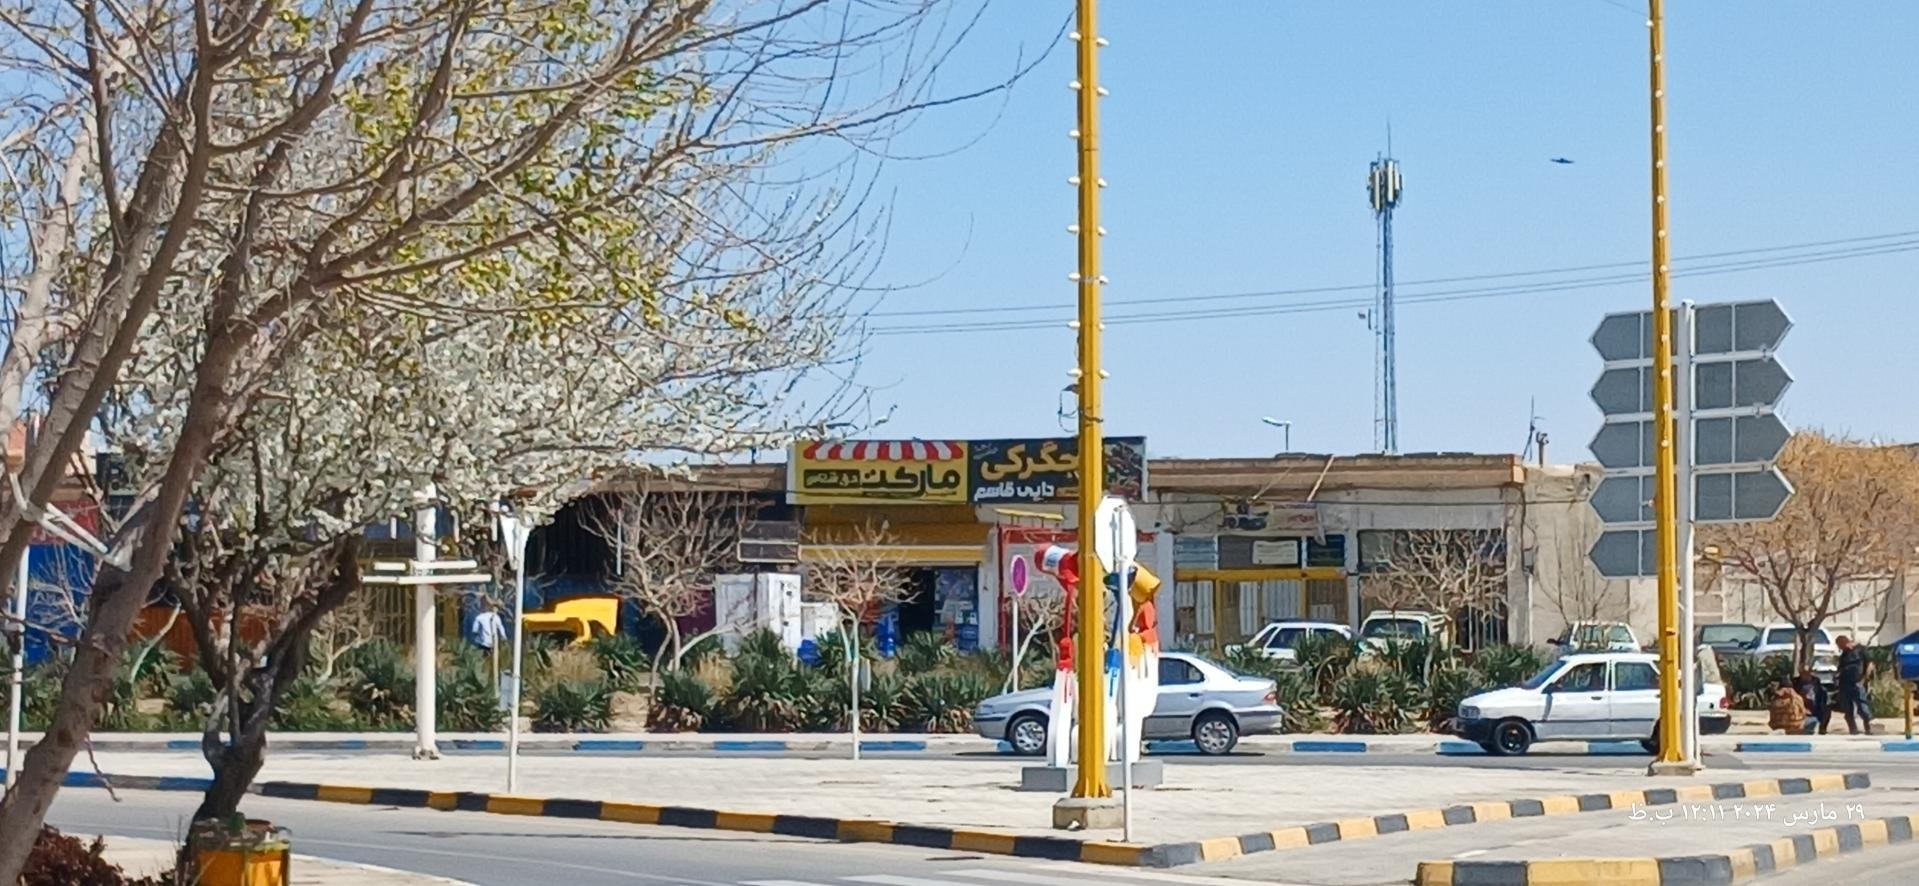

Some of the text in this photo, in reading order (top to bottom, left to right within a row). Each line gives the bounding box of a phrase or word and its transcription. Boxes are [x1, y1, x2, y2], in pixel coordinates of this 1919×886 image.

[981, 441, 1080, 480] جگرکی
[861, 464, 961, 498] مارکت
[974, 481, 1055, 502] دایی قاسم
